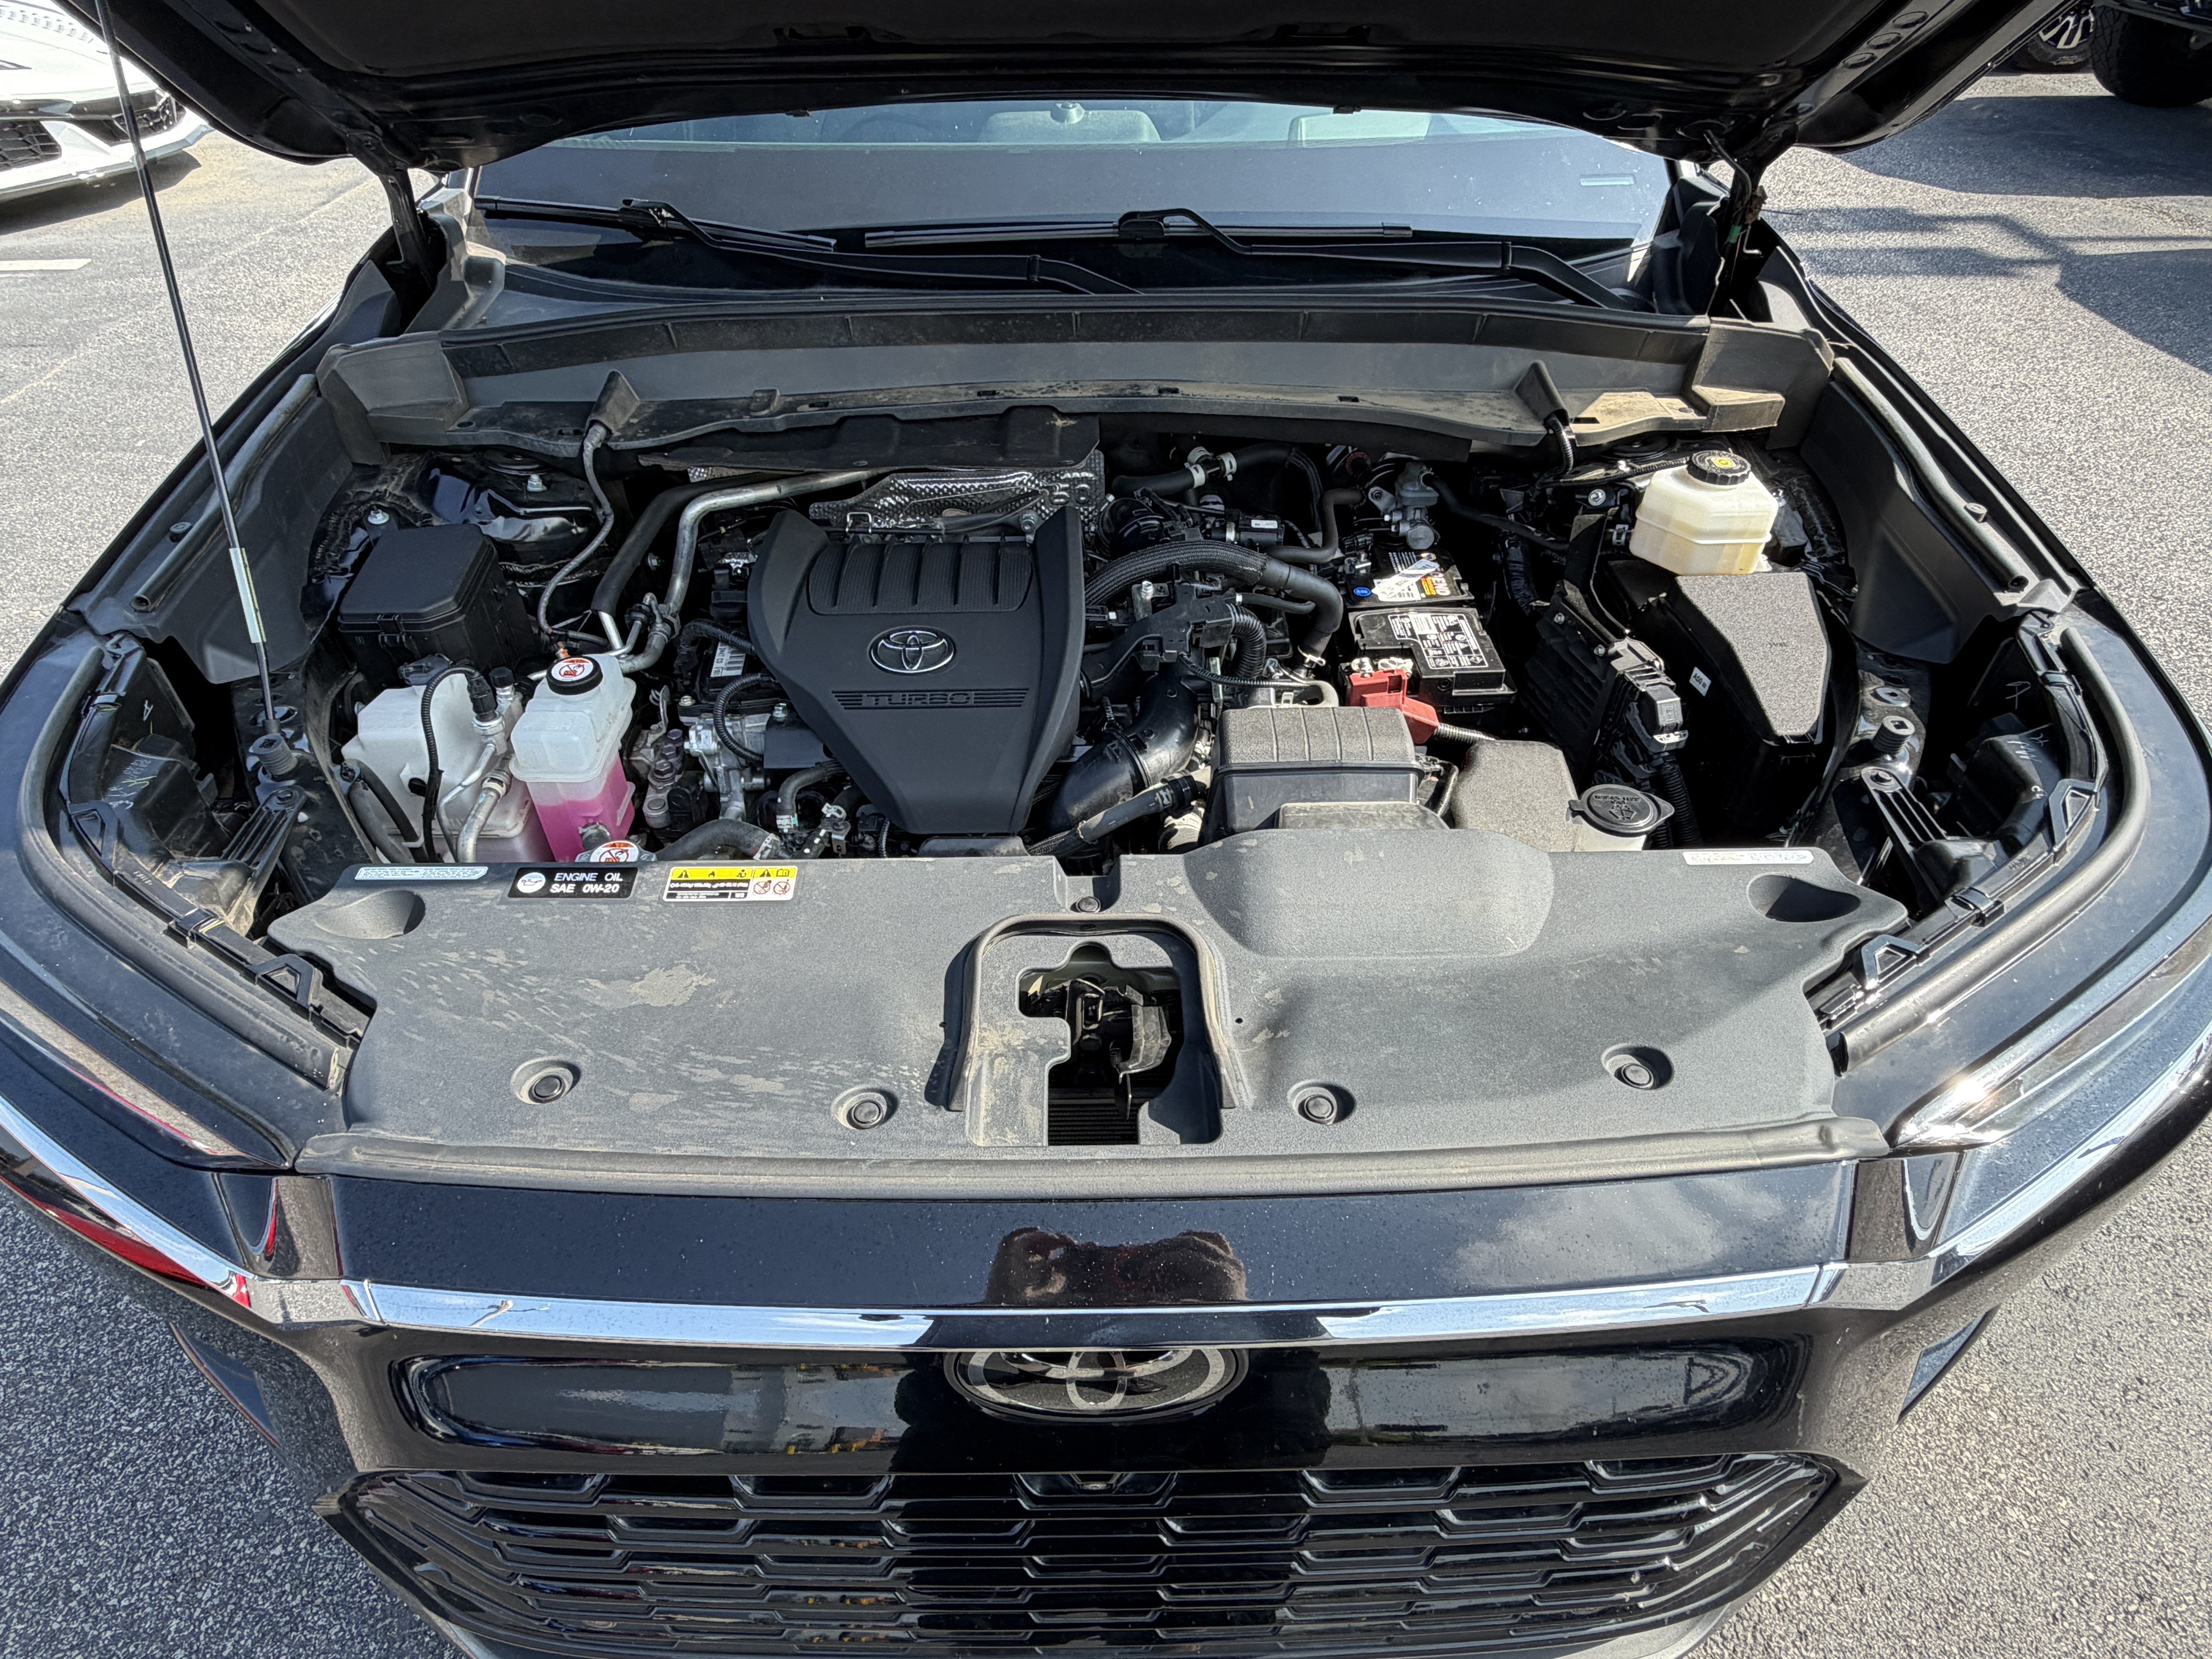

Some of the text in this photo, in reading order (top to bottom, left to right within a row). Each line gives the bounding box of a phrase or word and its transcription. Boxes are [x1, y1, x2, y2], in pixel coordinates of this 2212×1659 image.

[866, 692, 971, 706] TURBO
[554, 872, 623, 882] ENGINE OIL
[549, 883, 620, 893] SAE 0W-20
